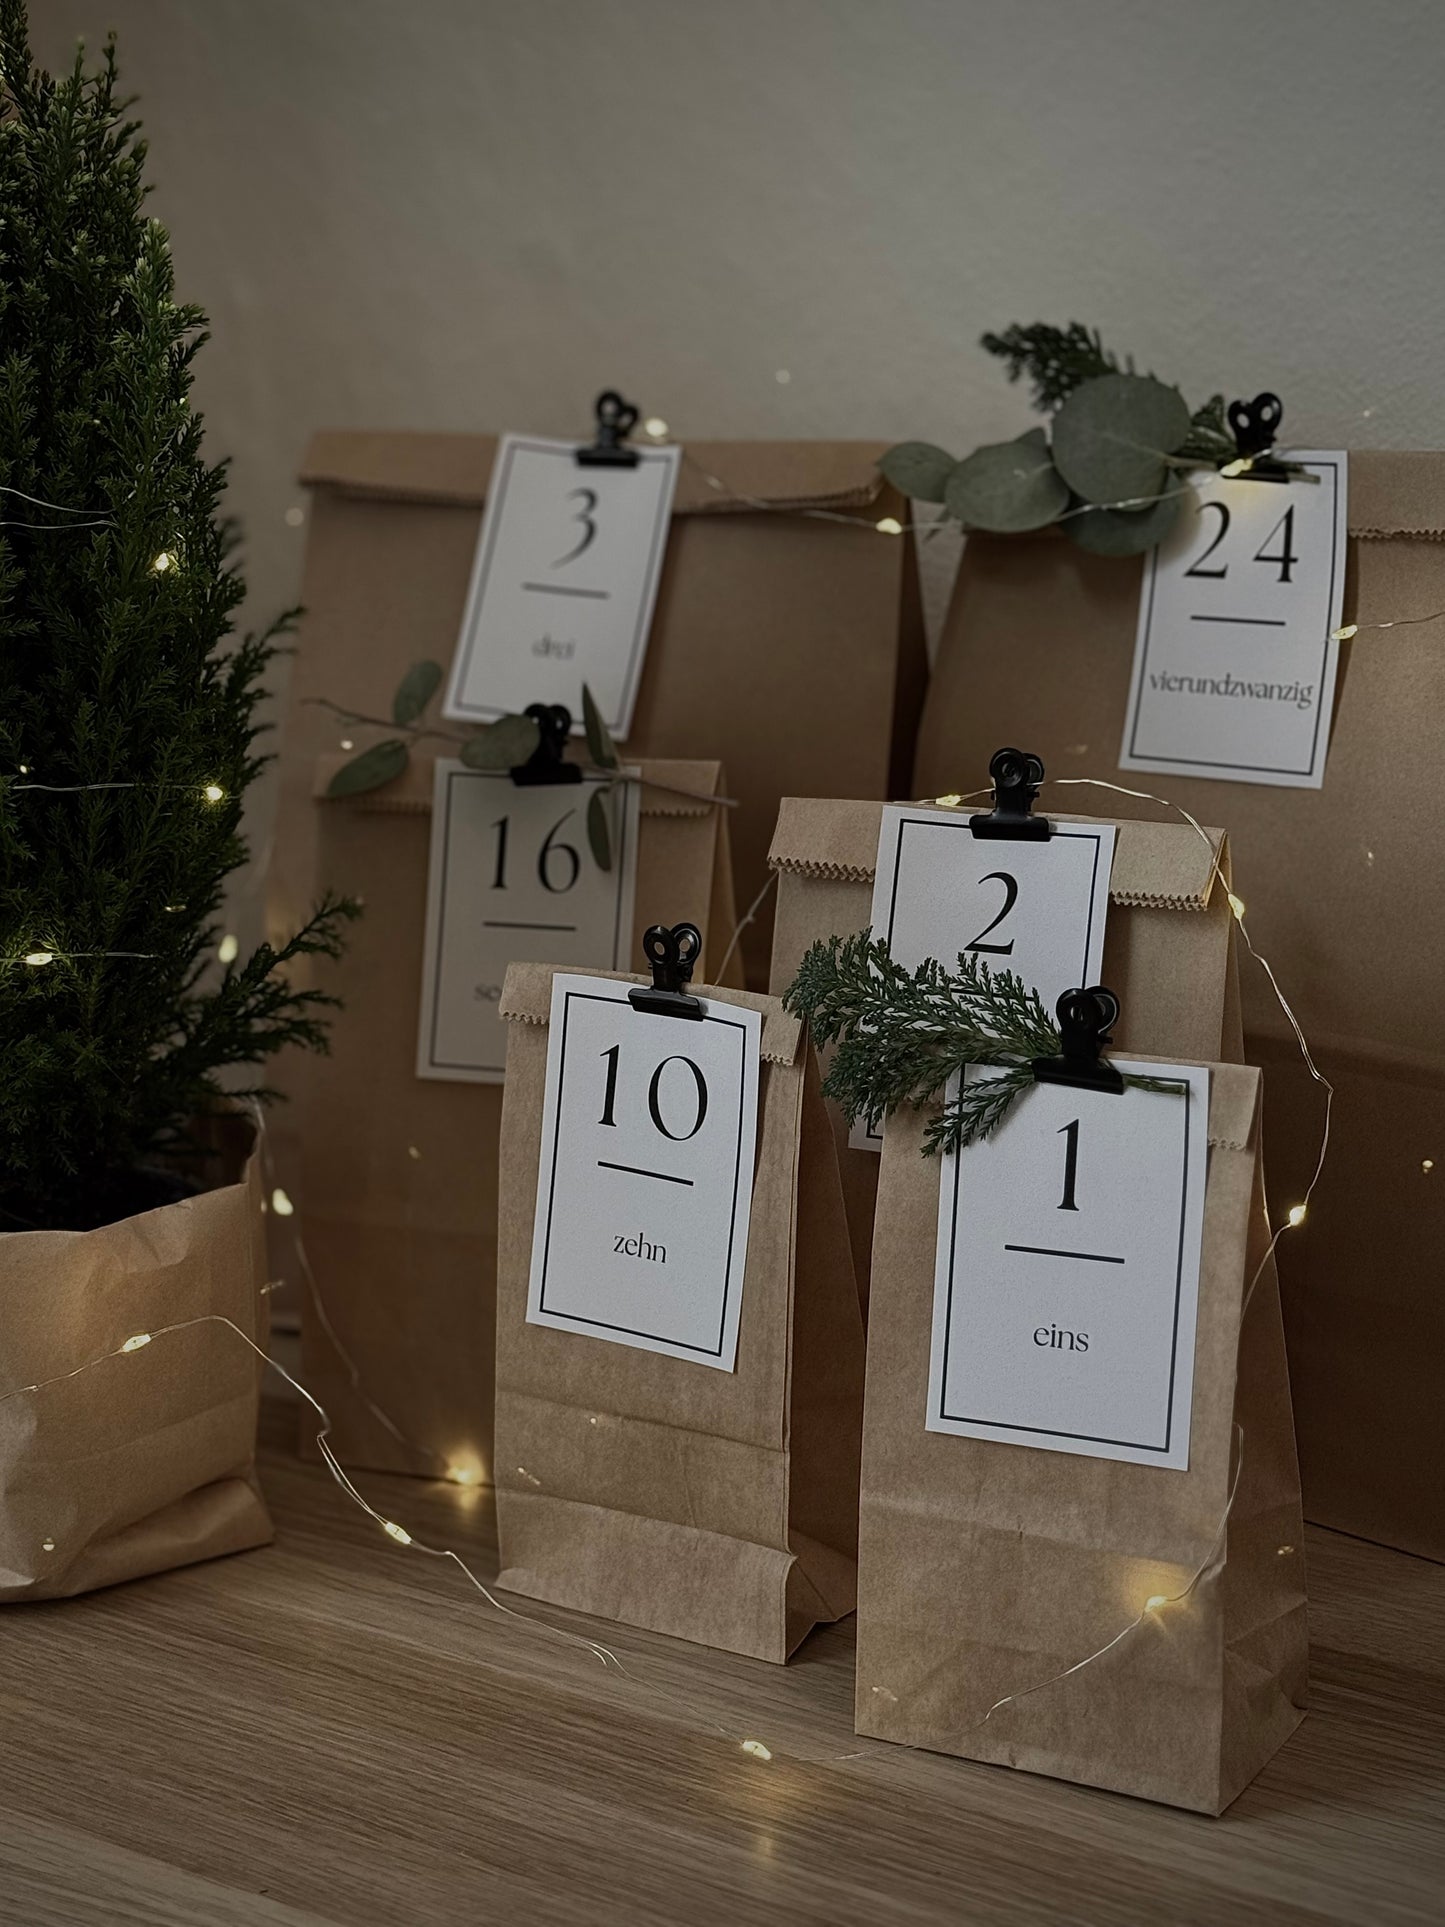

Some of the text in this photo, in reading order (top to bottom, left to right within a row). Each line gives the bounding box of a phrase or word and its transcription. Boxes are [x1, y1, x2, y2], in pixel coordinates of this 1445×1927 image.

[550, 487, 599, 570] 3
[1183, 501, 1299, 584] 24
[1149, 671, 1314, 711] vierundzwanzig
[489, 808, 581, 895] 16
[963, 871, 1019, 956] 2
[597, 1044, 708, 1141] 10
[1056, 1118, 1080, 1212] 1
[613, 1232, 667, 1264] zehn
[1033, 1323, 1089, 1353] eins
